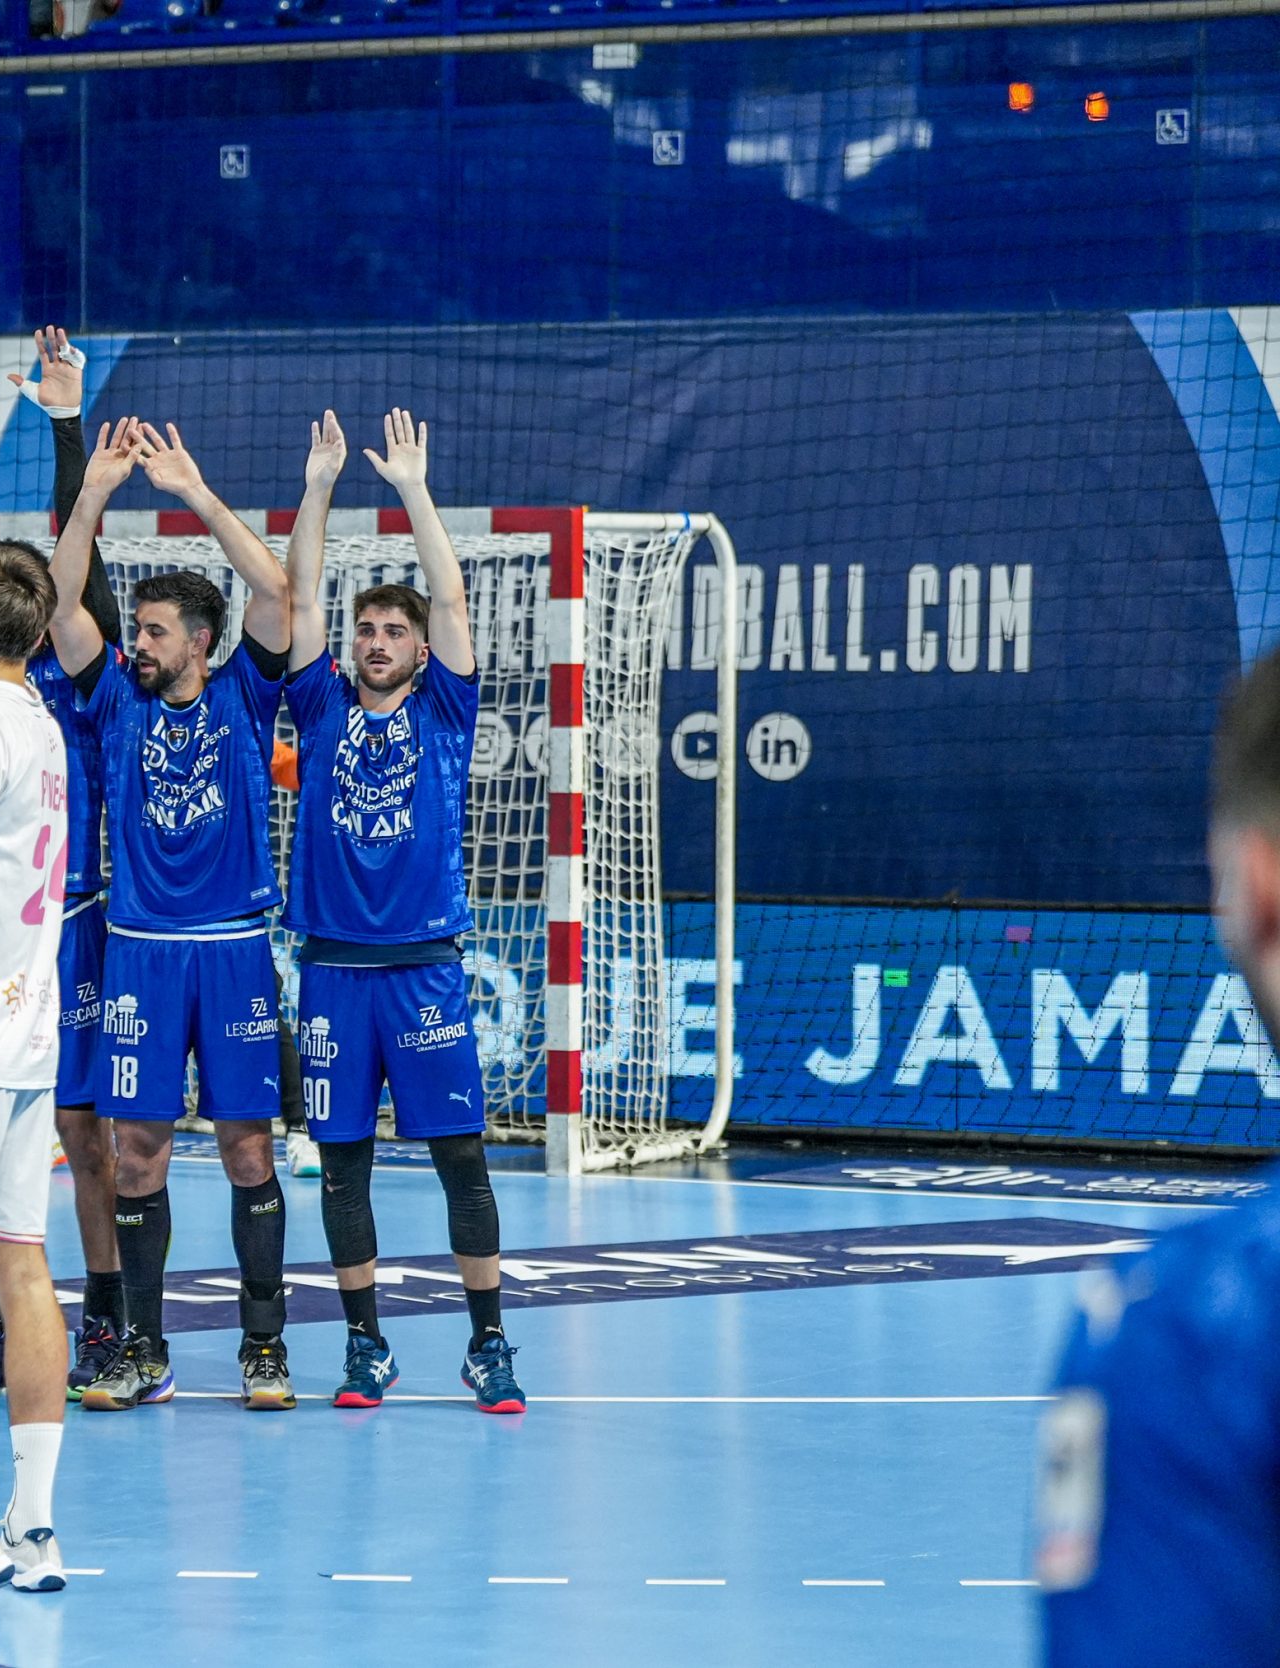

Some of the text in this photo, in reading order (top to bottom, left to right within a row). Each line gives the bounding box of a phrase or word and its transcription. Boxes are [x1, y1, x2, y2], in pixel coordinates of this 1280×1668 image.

[184, 784, 224, 826] AIR
[103, 1000, 149, 1045] Philip
[300, 1021, 339, 1068] Philip
[111, 1055, 138, 1099] 18
[303, 1077, 330, 1120] 90
